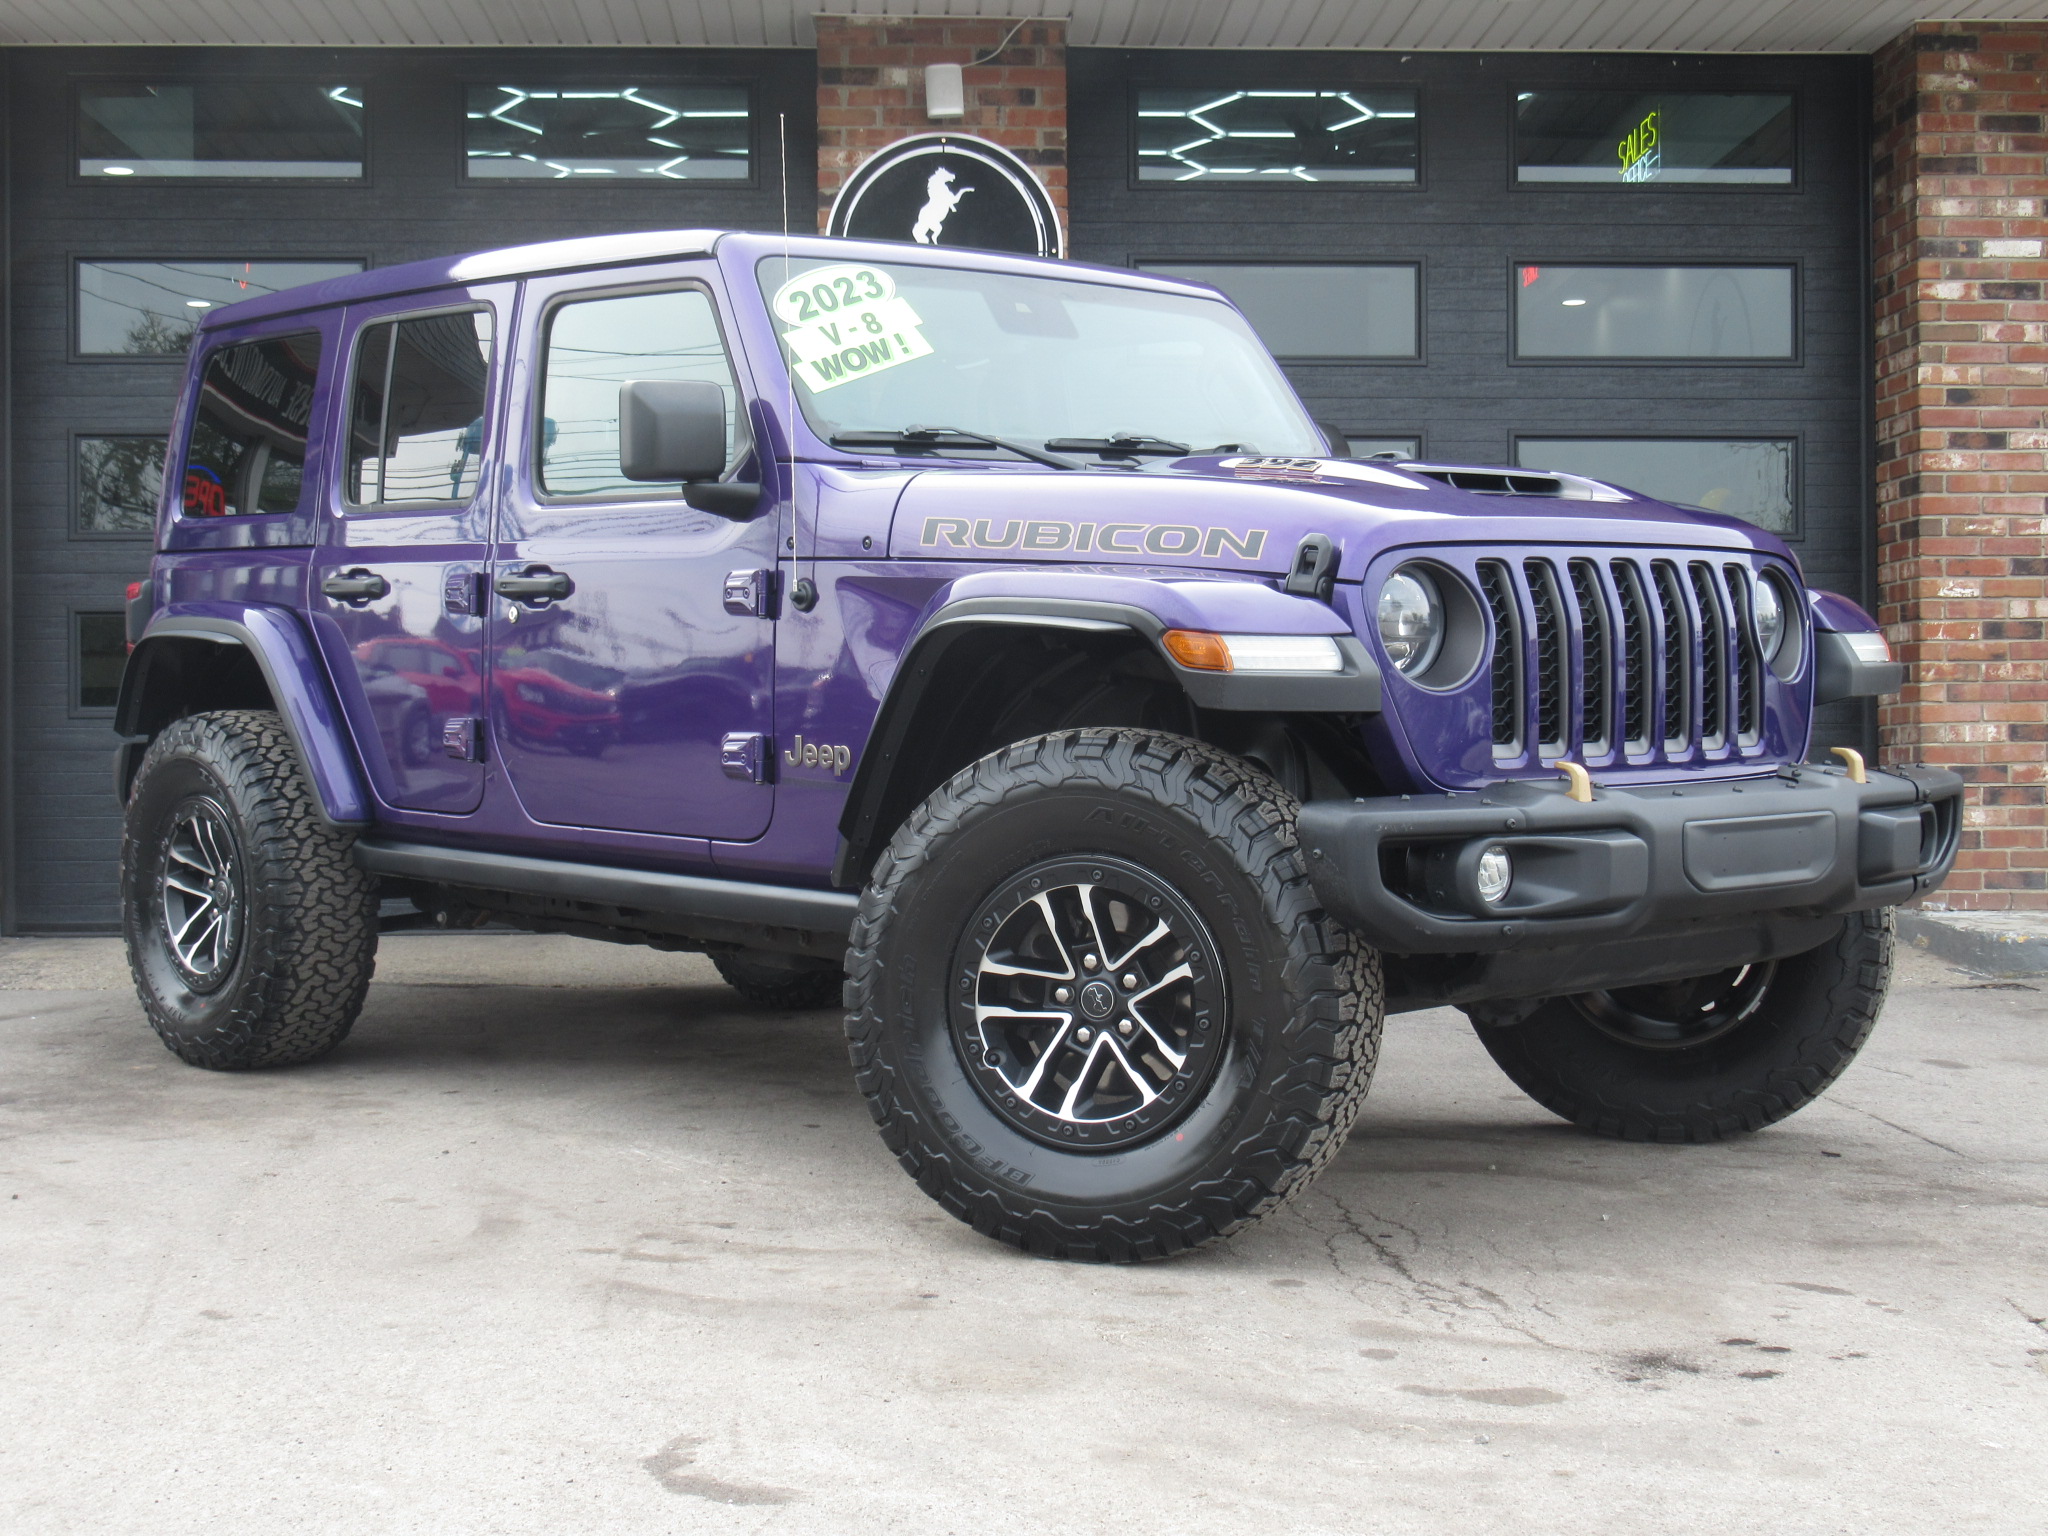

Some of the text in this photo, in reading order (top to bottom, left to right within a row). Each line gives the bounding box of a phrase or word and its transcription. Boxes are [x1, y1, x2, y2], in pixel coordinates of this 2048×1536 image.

[1618, 112, 1656, 174] SALES
[789, 270, 884, 321] 2023
[818, 322, 842, 346] V
[861, 312, 883, 334] 8
[810, 337, 894, 383] WOW
[920, 516, 1268, 560] RUBICON
[784, 734, 851, 776] Jeep
